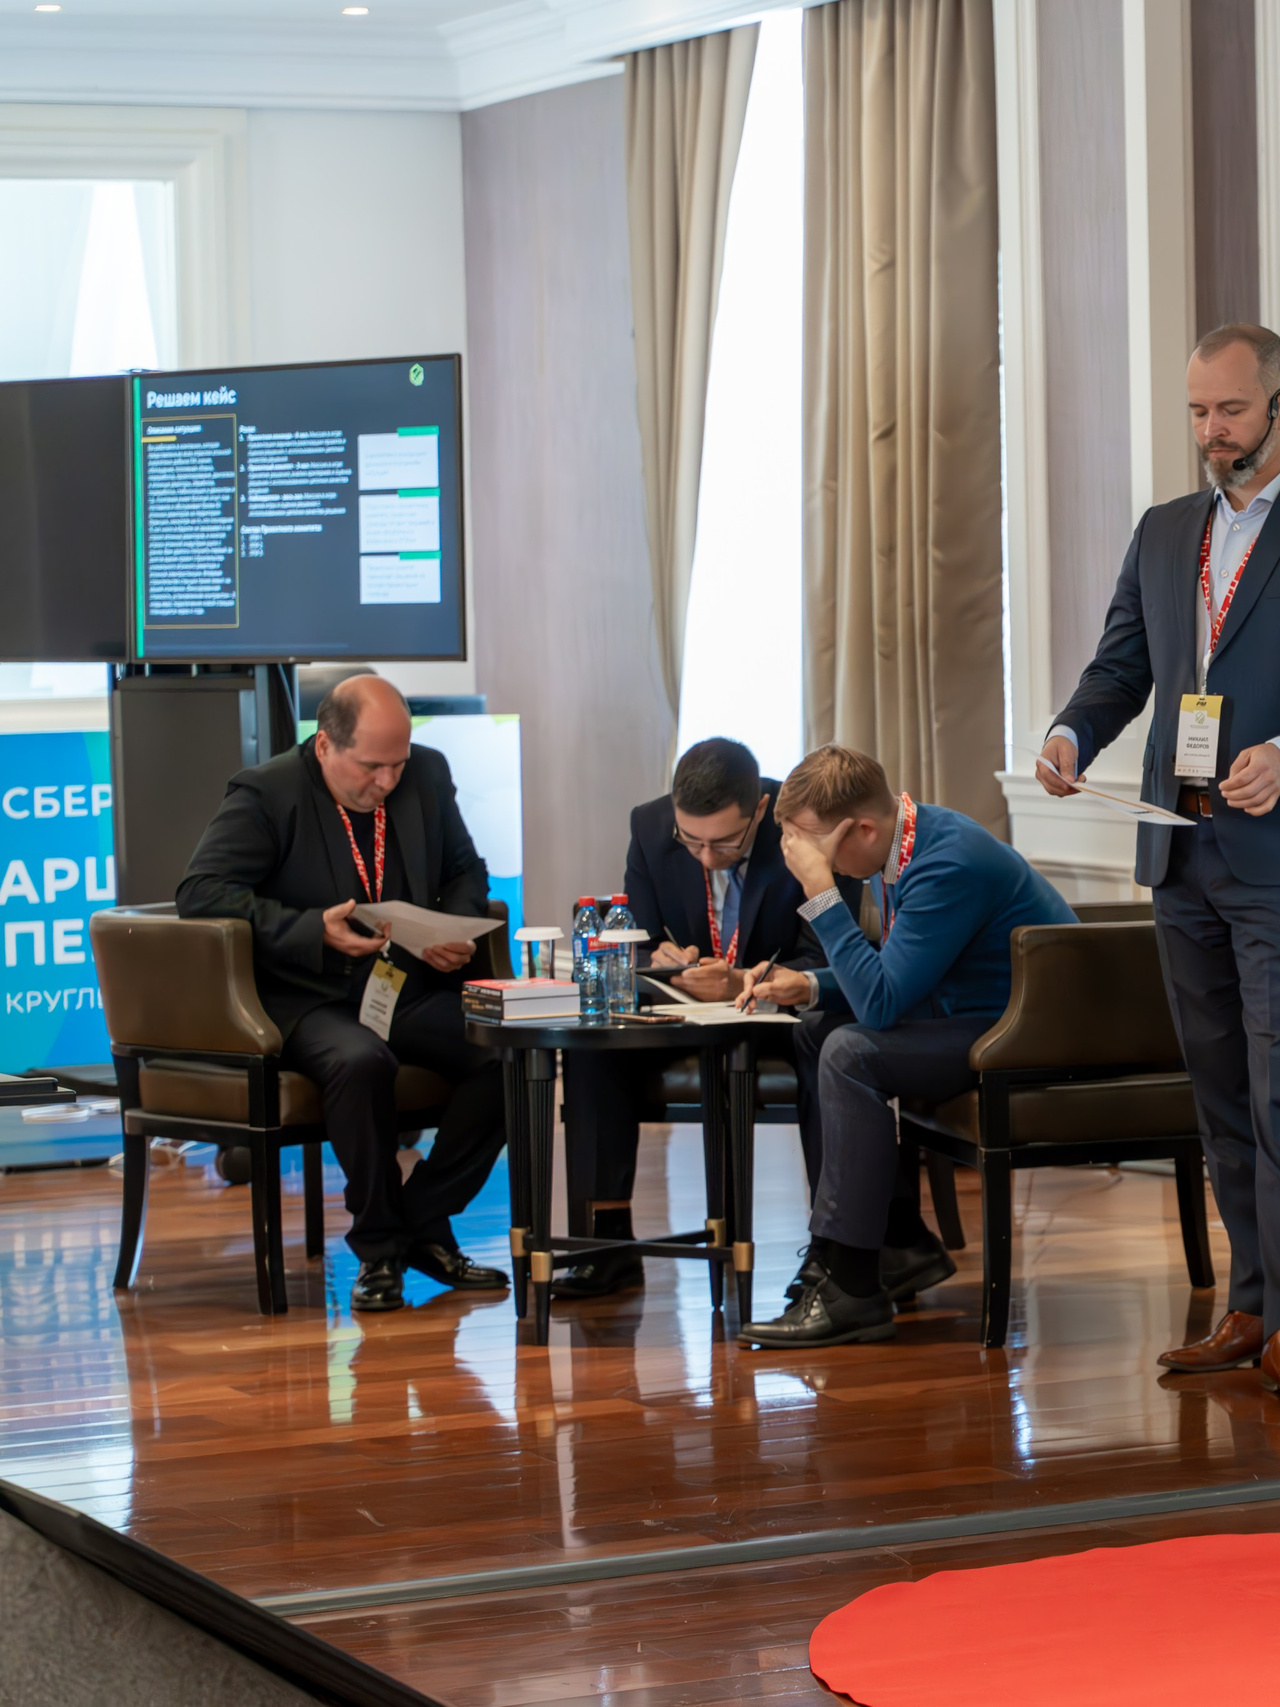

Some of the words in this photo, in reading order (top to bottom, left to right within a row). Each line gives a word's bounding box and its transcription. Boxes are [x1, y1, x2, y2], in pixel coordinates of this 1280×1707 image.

[147, 391, 201, 409] Решаем
[203, 386, 237, 406] кейс
[2, 784, 113, 819] СБЕР
[5, 919, 95, 967] ПЕ
